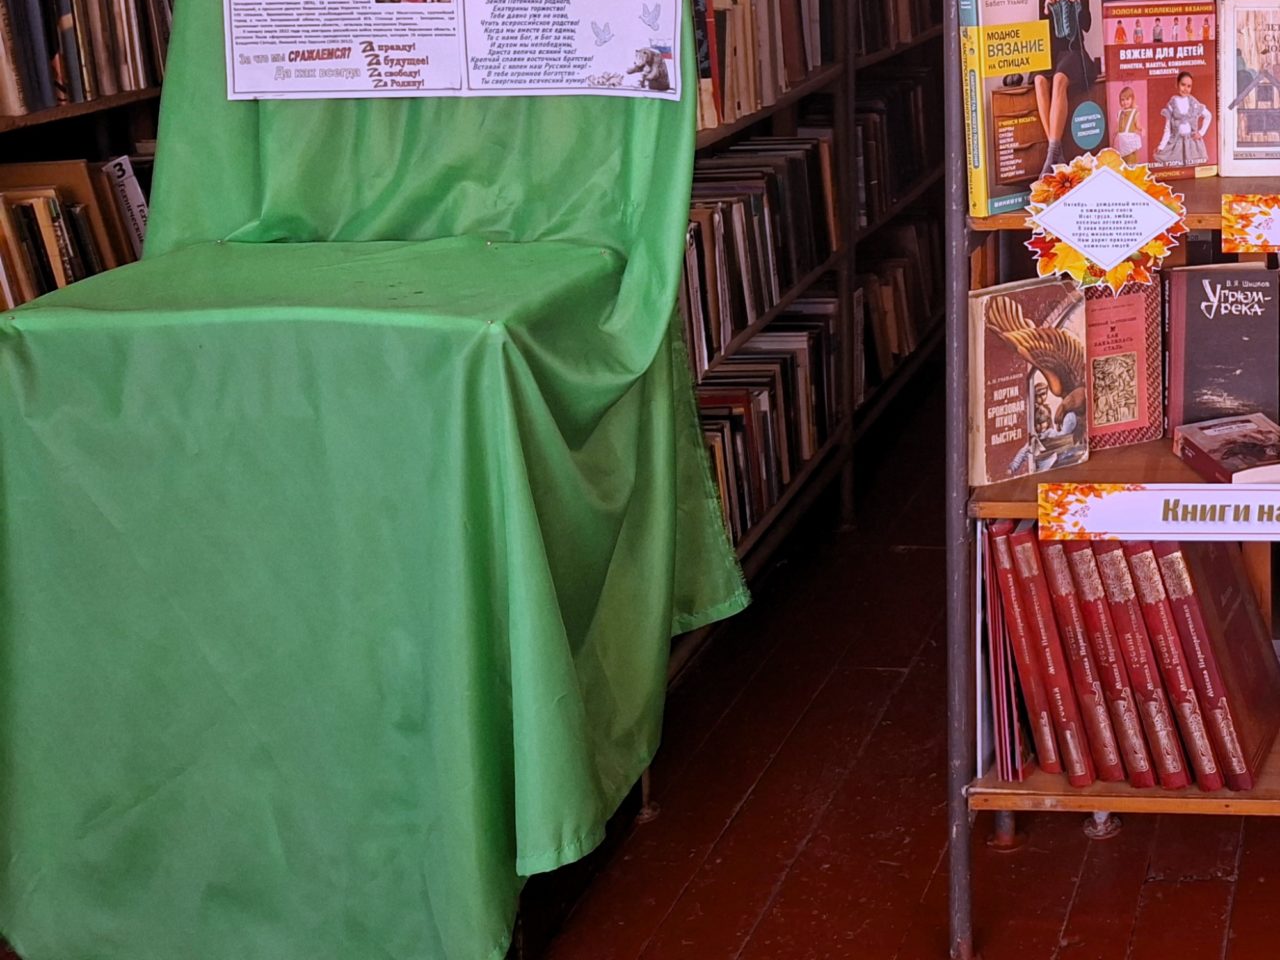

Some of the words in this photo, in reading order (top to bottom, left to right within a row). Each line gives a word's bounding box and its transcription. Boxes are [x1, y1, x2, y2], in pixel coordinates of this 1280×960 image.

[986, 29, 1020, 41] МОДНОЕ
[288, 46, 352, 63] СРАЖАЕМСЯ?
[987, 38, 1045, 58] ВЯЗАНИЕ
[1119, 47, 1154, 60] ВЯЖЕМ
[1155, 47, 1175, 60] ДЛЯ
[1176, 43, 1204, 58] ДЕТЕЙ
[383, 55, 430, 68] будущее!
[998, 58, 1031, 70] СПИЦАХ
[1200, 279, 1272, 319] Угрюм-
[1161, 498, 1250, 523] Книги
